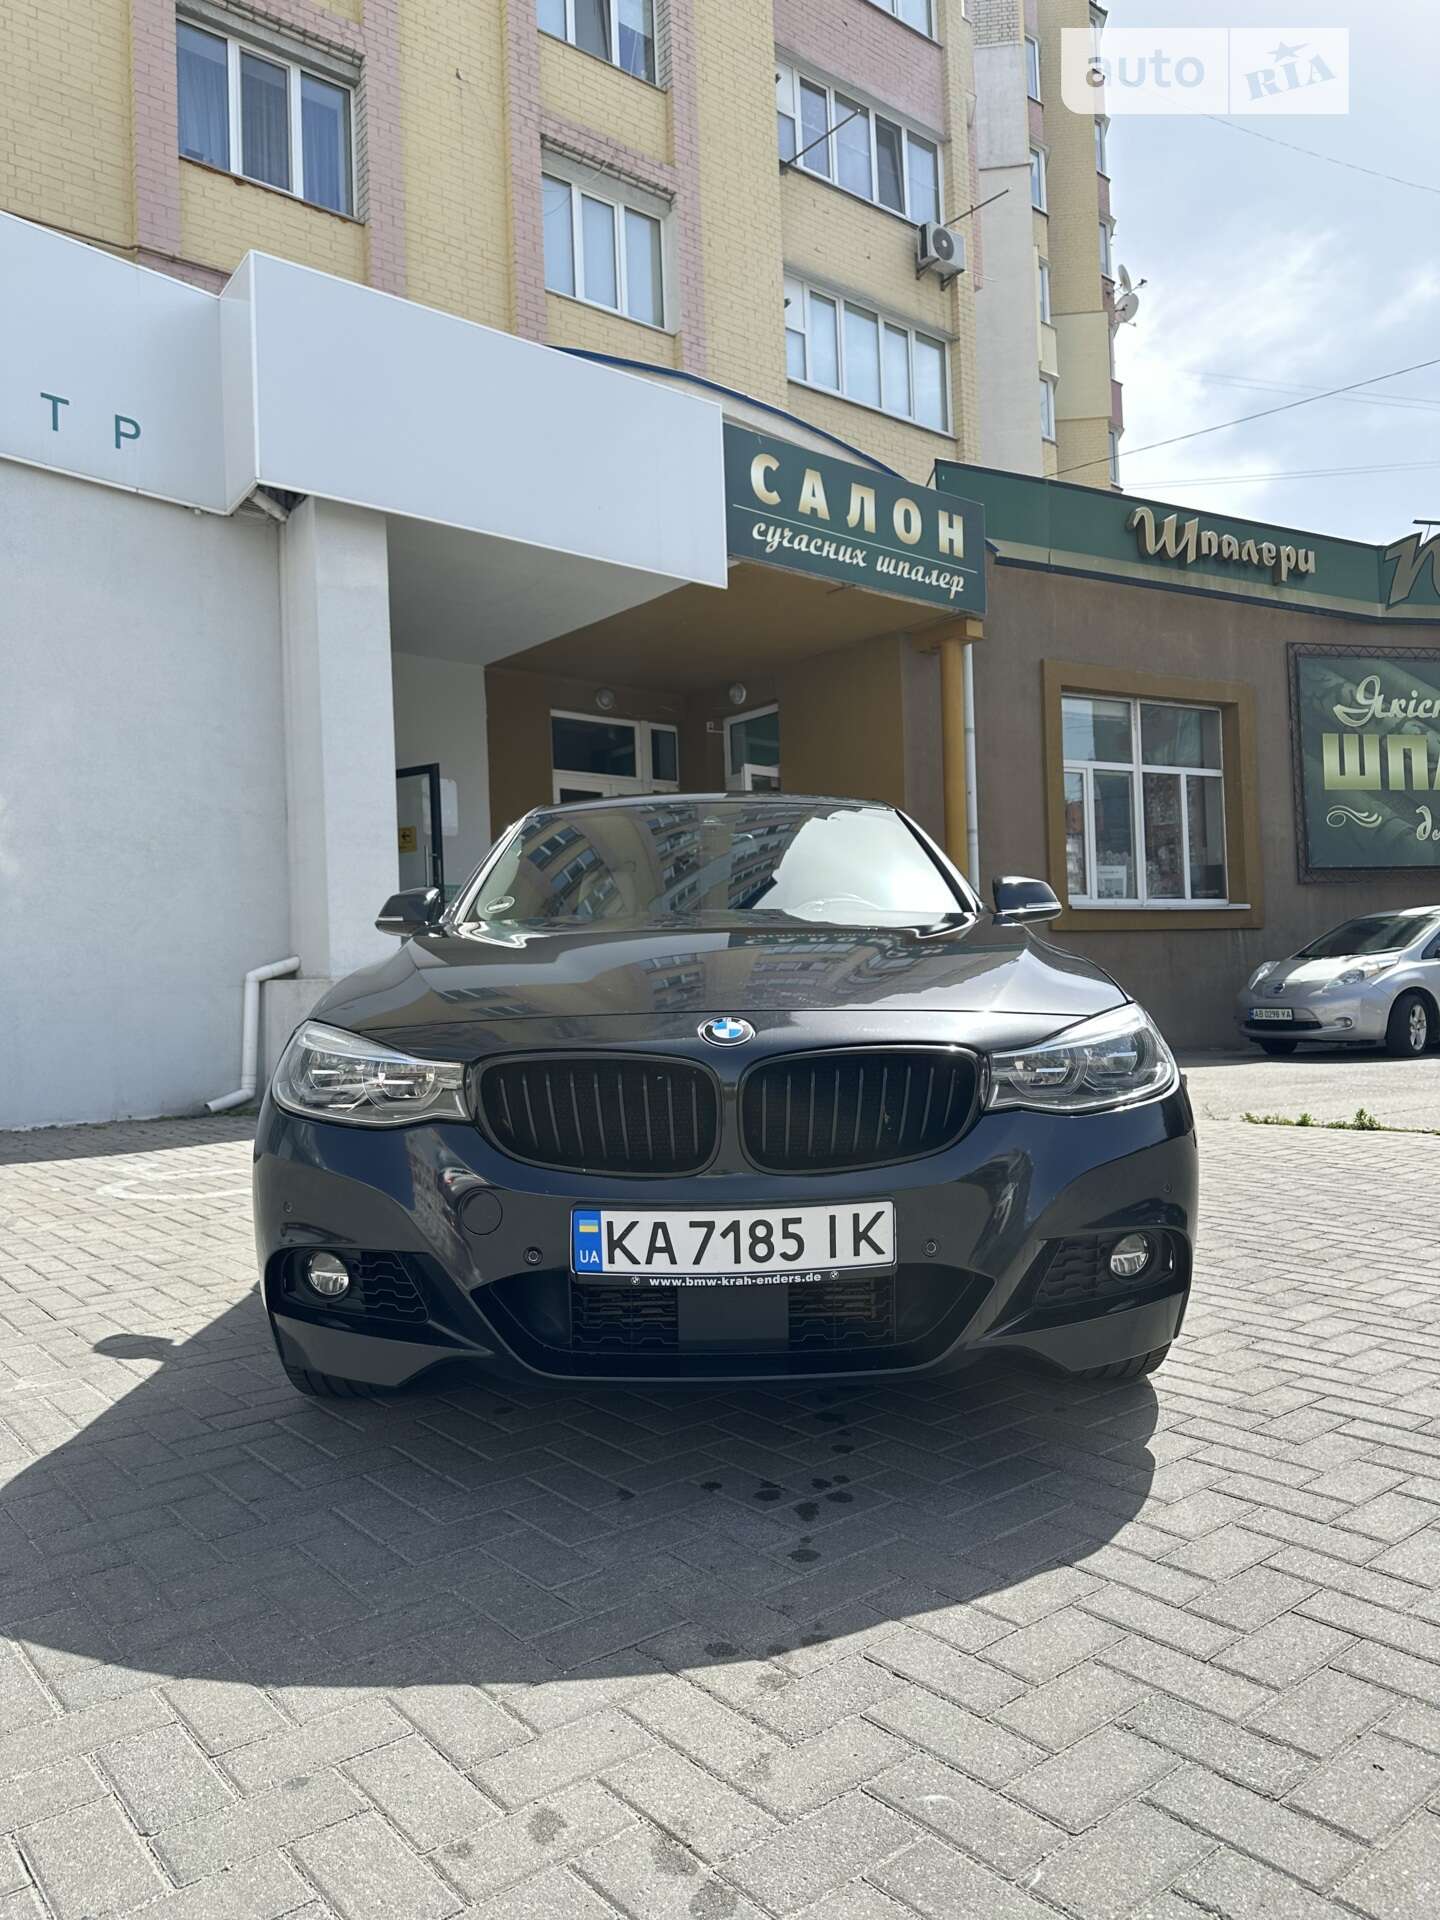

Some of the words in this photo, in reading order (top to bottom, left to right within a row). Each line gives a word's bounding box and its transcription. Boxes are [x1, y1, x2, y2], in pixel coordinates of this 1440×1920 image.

[750, 453, 965, 559] САЛОН
[752, 522, 867, 568] сучасних
[876, 554, 965, 600] шпалер
[1129, 506, 1316, 583] Шпалери
[1322, 733, 1440, 791] ШП
[579, 1250, 600, 1264] UA
[649, 1273, 822, 1287] www.bmw-krah-enders.de
